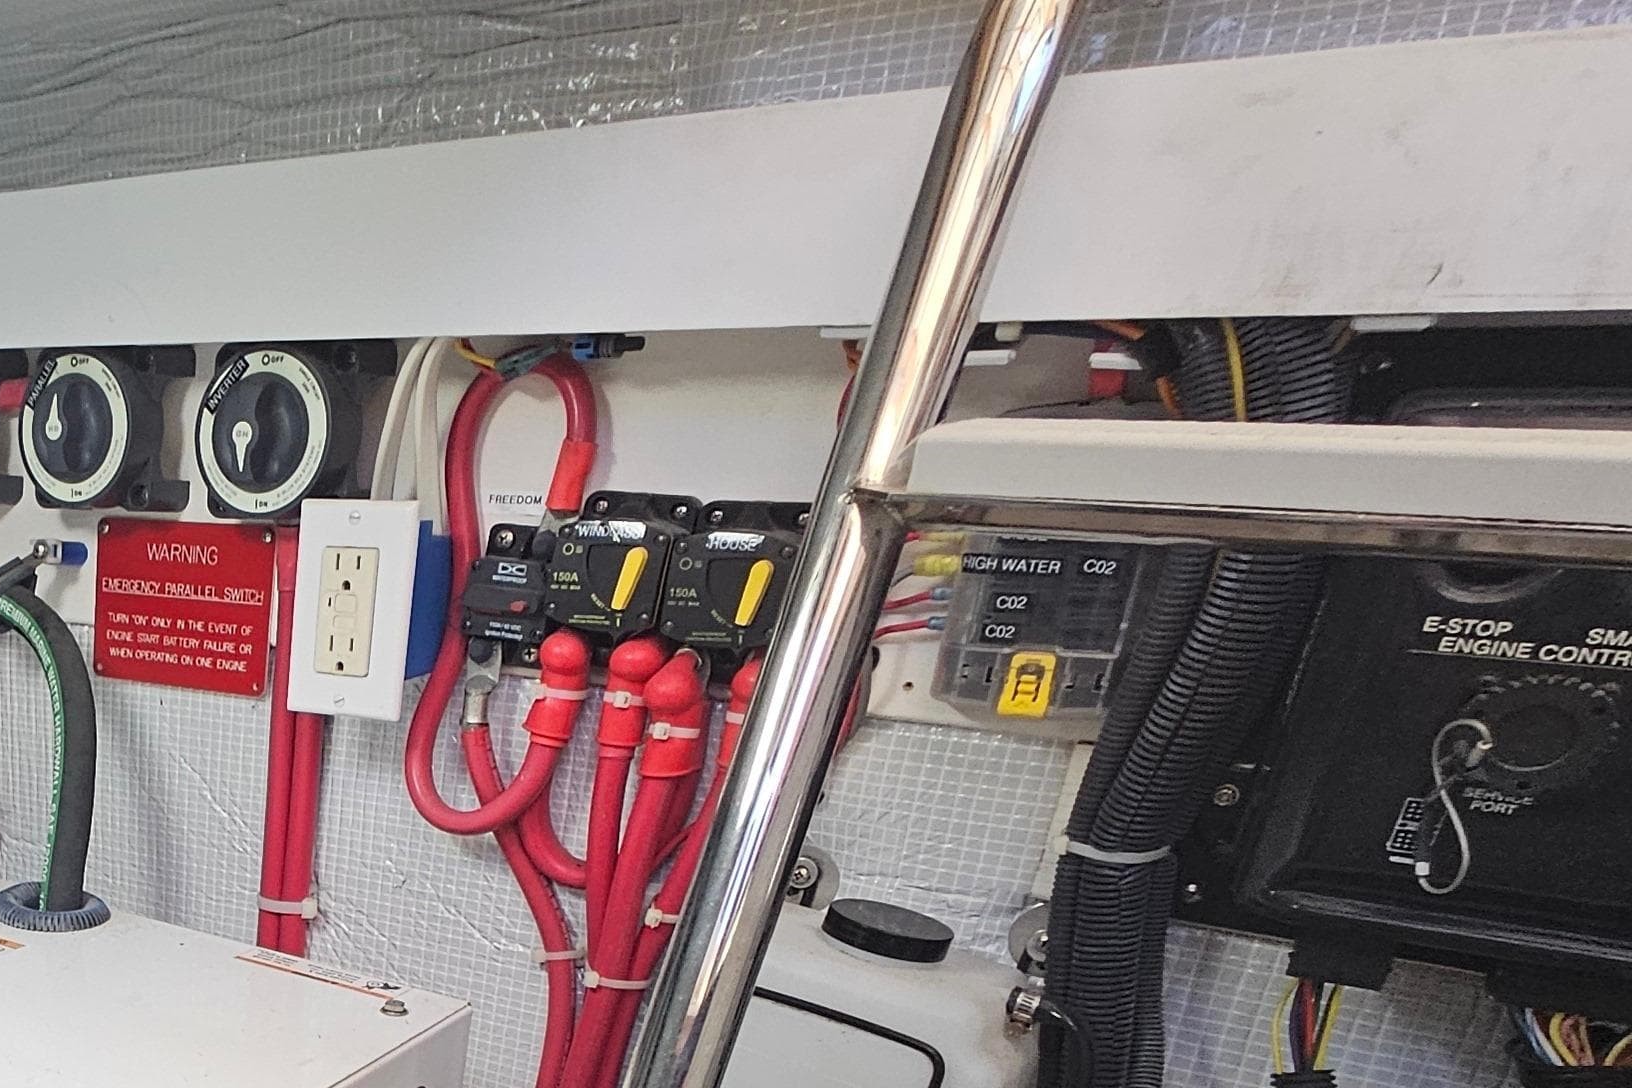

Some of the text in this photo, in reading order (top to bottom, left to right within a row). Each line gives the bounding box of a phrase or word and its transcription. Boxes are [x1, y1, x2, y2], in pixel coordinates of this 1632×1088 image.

[270, 355, 284, 364] OFF
[27, 360, 57, 407] PARALLEL
[207, 359, 246, 411] INVERTER
[488, 494, 543, 505] FREEDOM
[146, 542, 219, 566] WARNING
[709, 535, 760, 552] HOUSE
[552, 571, 579, 582] 150A
[962, 555, 1062, 574] HIGH WATER
[102, 577, 265, 605] EMERGENCY PARALLEL SWITCH
[669, 587, 698, 598] 150A
[107, 611, 130, 625] TURN
[151, 615, 173, 629] ONLY
[176, 619, 185, 630] IN
[188, 619, 205, 632] THE
[208, 622, 237, 636] EVENT
[240, 625, 254, 636] OF
[1421, 615, 1514, 637] E-STOP
[106, 628, 253, 655] ENGINE START BATTERY FAILURE OR
[1436, 636, 1632, 667] ENGINE CONTR
[27, 627, 52, 672] MARINE
[47, 669, 61, 712] WATER
[109, 646, 248, 673] WHEN OPERATING ON ONE ENGINE
[1469, 800, 1520, 817] PORT
